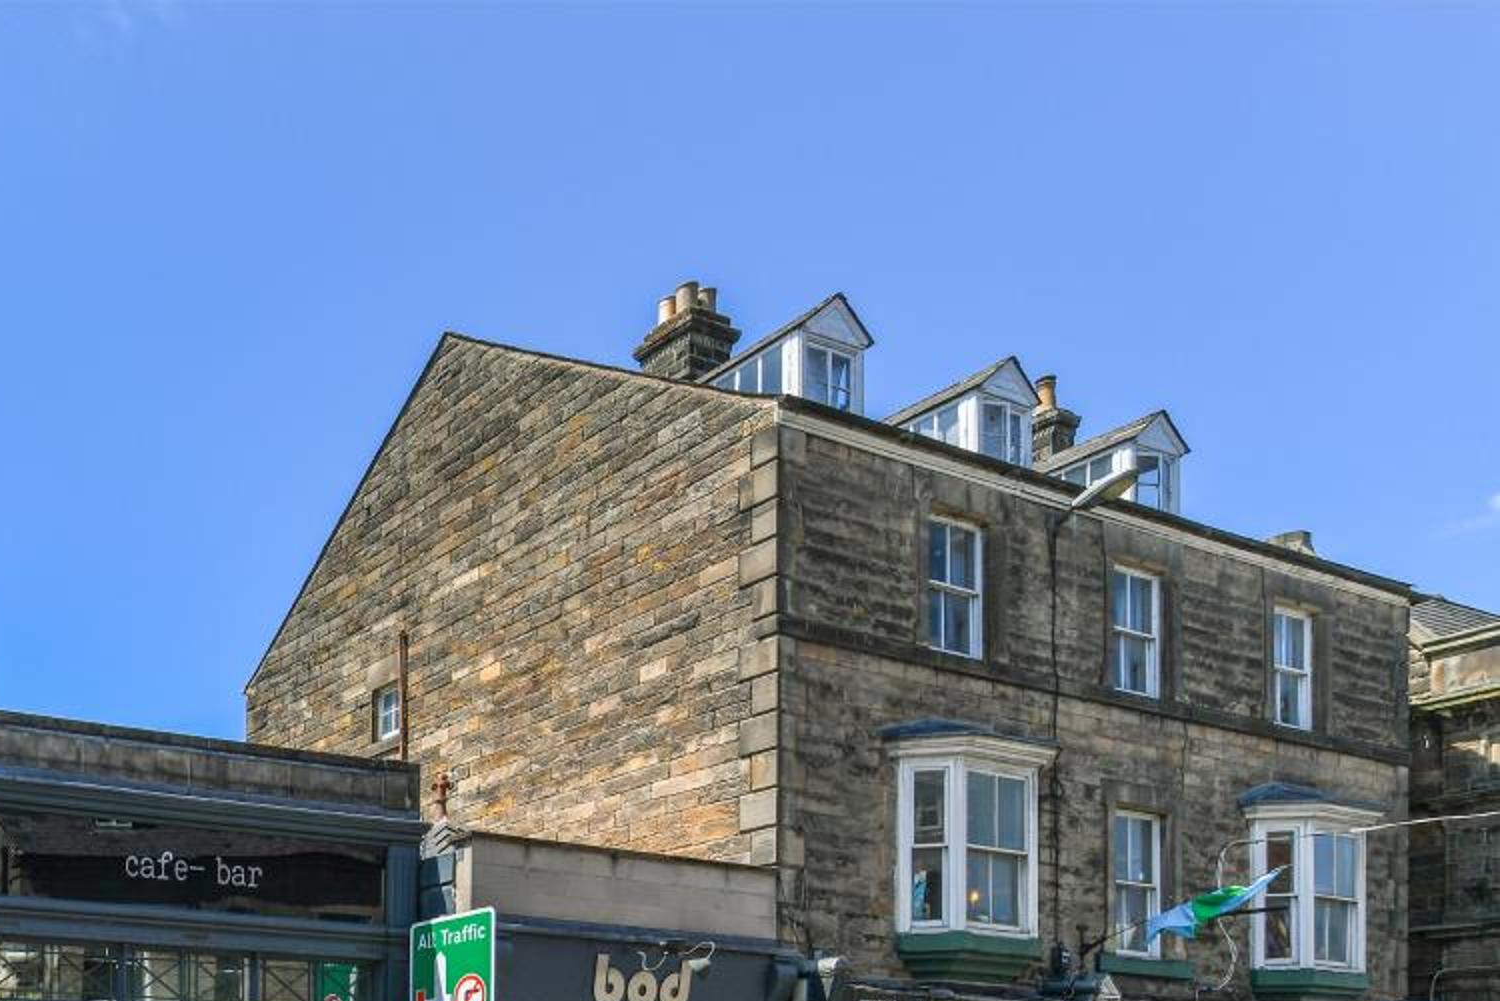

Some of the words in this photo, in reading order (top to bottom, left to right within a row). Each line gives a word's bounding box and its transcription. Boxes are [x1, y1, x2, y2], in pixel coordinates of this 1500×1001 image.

[216, 857, 263, 888] bar
[418, 932, 436, 950] All
[442, 923, 486, 946] Traffic
